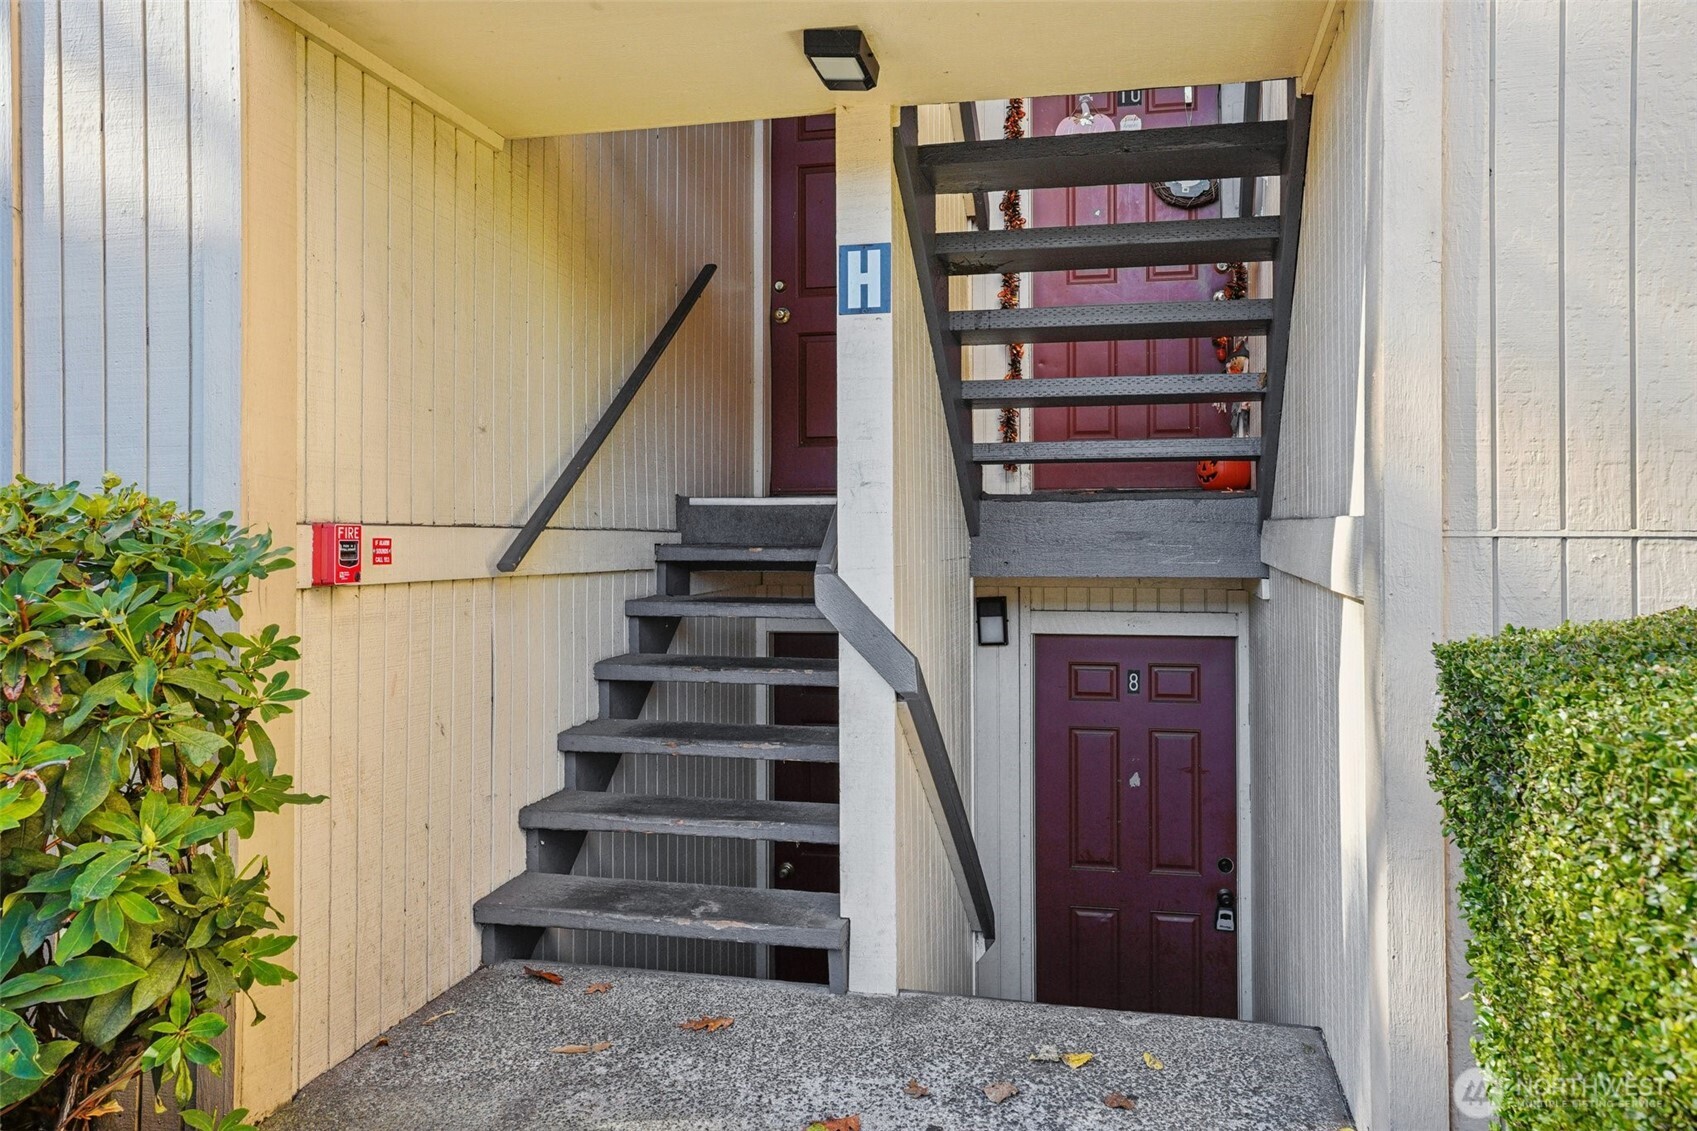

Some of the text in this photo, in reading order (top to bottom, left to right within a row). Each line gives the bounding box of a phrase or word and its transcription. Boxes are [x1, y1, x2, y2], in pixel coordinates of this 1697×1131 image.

[1121, 90, 1140, 103] 10
[847, 249, 881, 309] H
[338, 526, 359, 539] FIRE
[1129, 673, 1138, 691] 8
